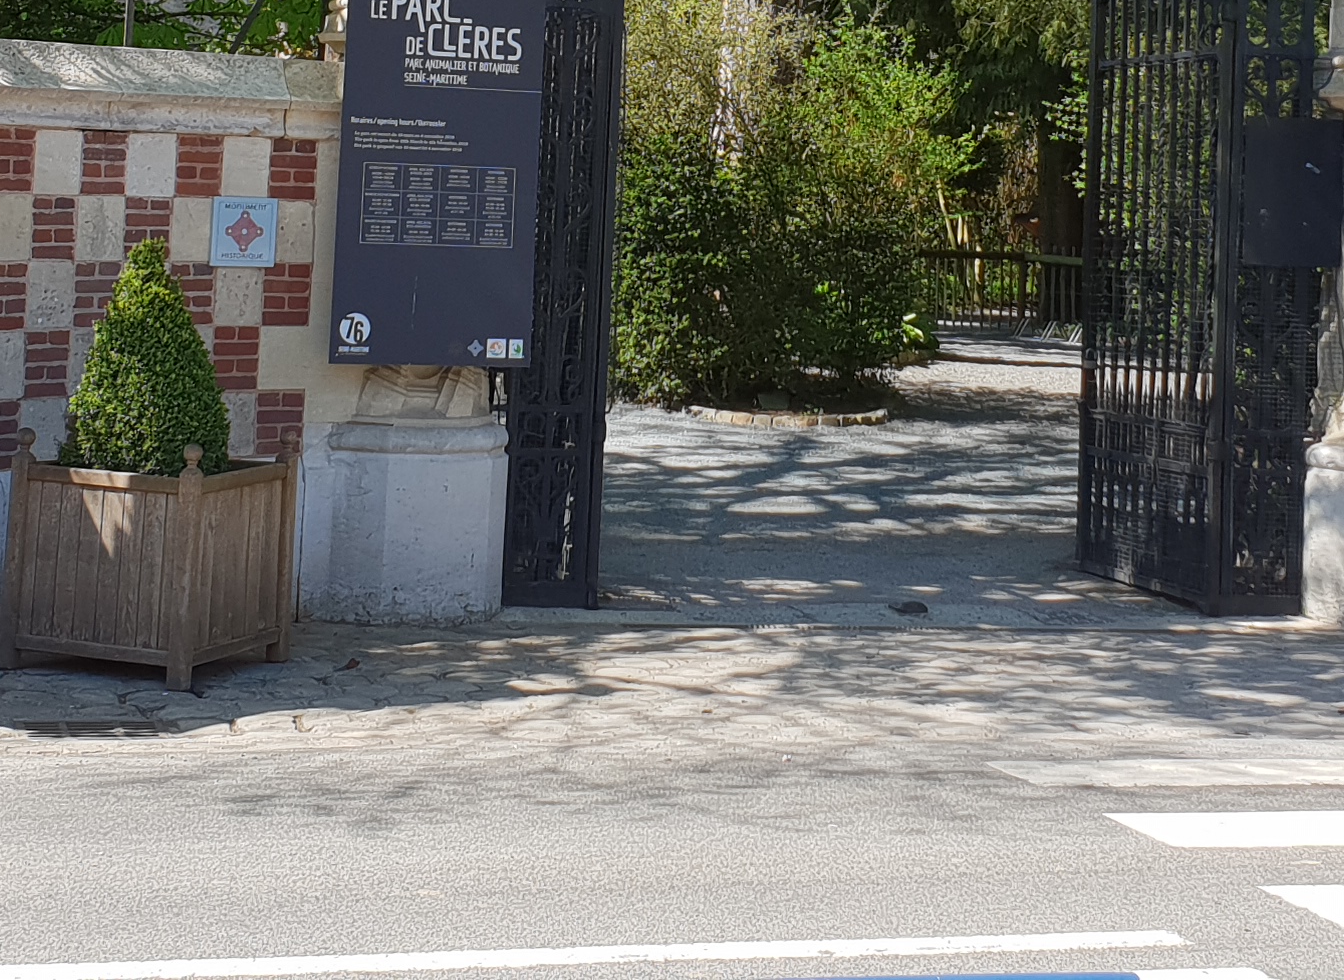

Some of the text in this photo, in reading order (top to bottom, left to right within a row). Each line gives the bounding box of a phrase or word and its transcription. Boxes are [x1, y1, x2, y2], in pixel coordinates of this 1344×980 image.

[370, 0, 388, 19] LE
[406, 36, 424, 56] DE
[404, 58, 520, 75] PARC ANIMALIER ET BOTANIQUE
[404, 70, 468, 86] SEINE-MARITIME
[342, 315, 365, 345] 76
